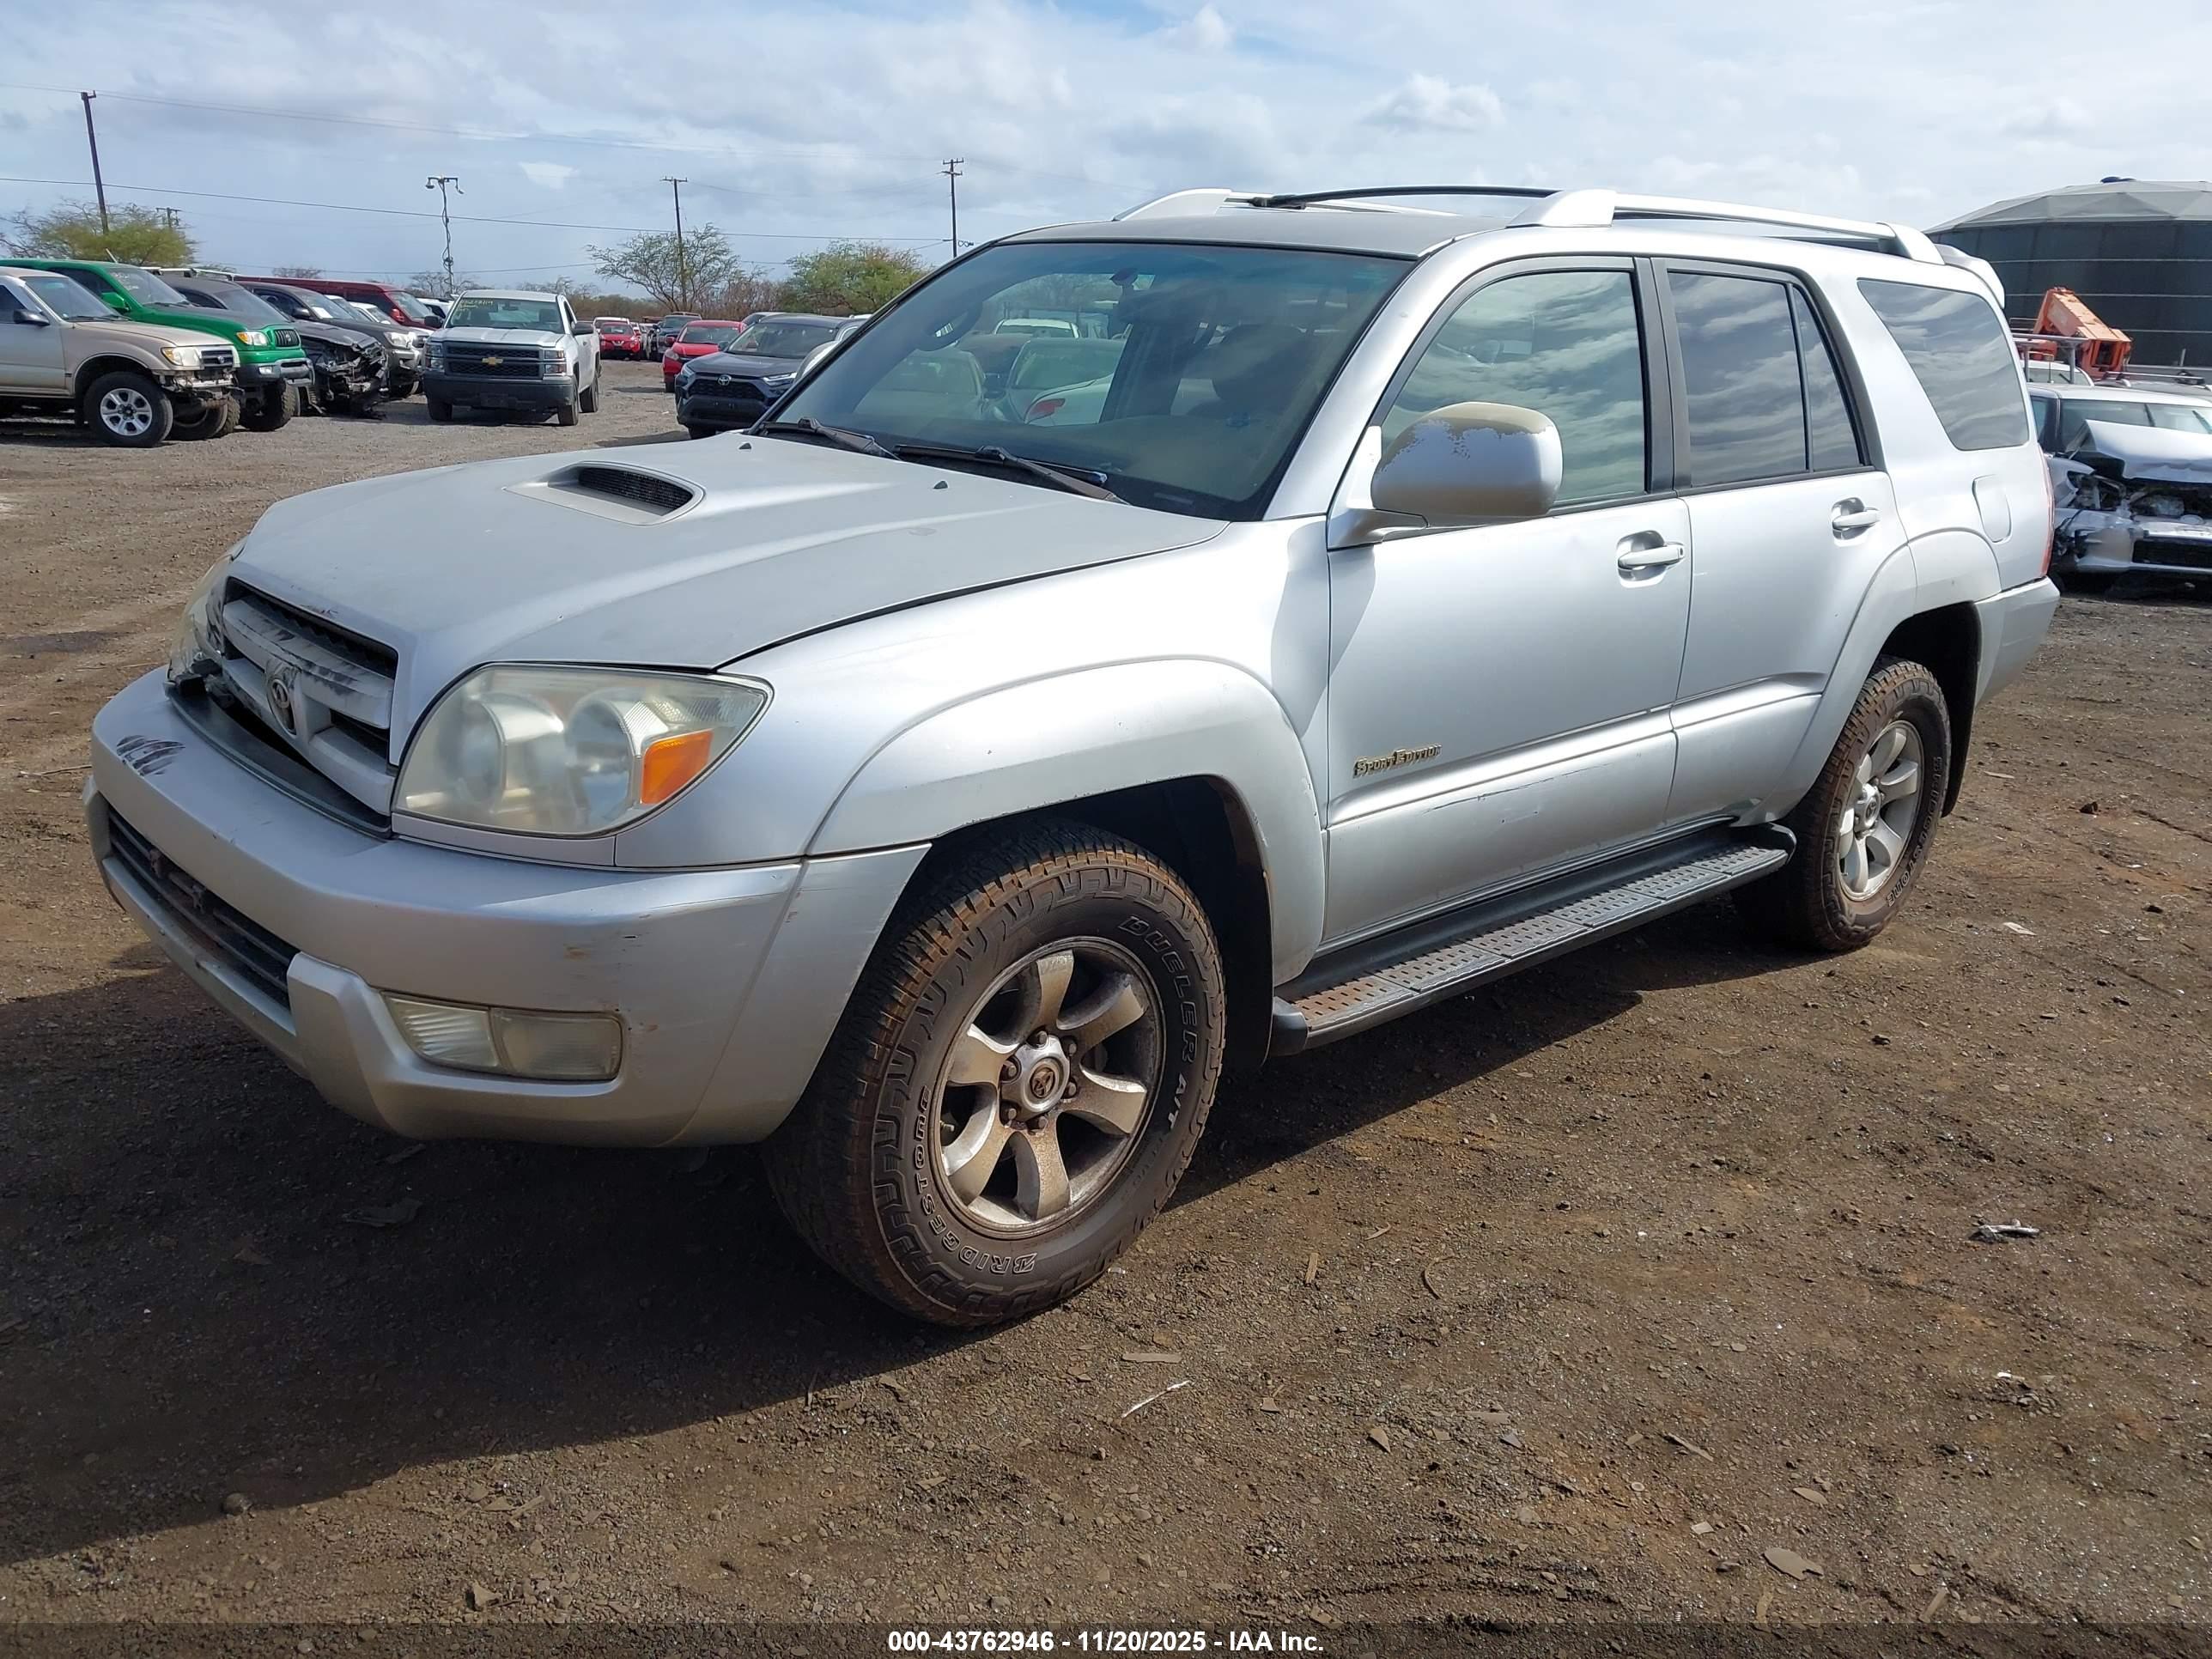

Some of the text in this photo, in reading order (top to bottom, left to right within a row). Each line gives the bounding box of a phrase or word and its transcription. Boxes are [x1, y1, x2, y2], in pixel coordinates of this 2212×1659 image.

[1117, 915, 1198, 1130] DUELER A/T
[913, 1085, 1038, 1274] BRIDGESTONE
